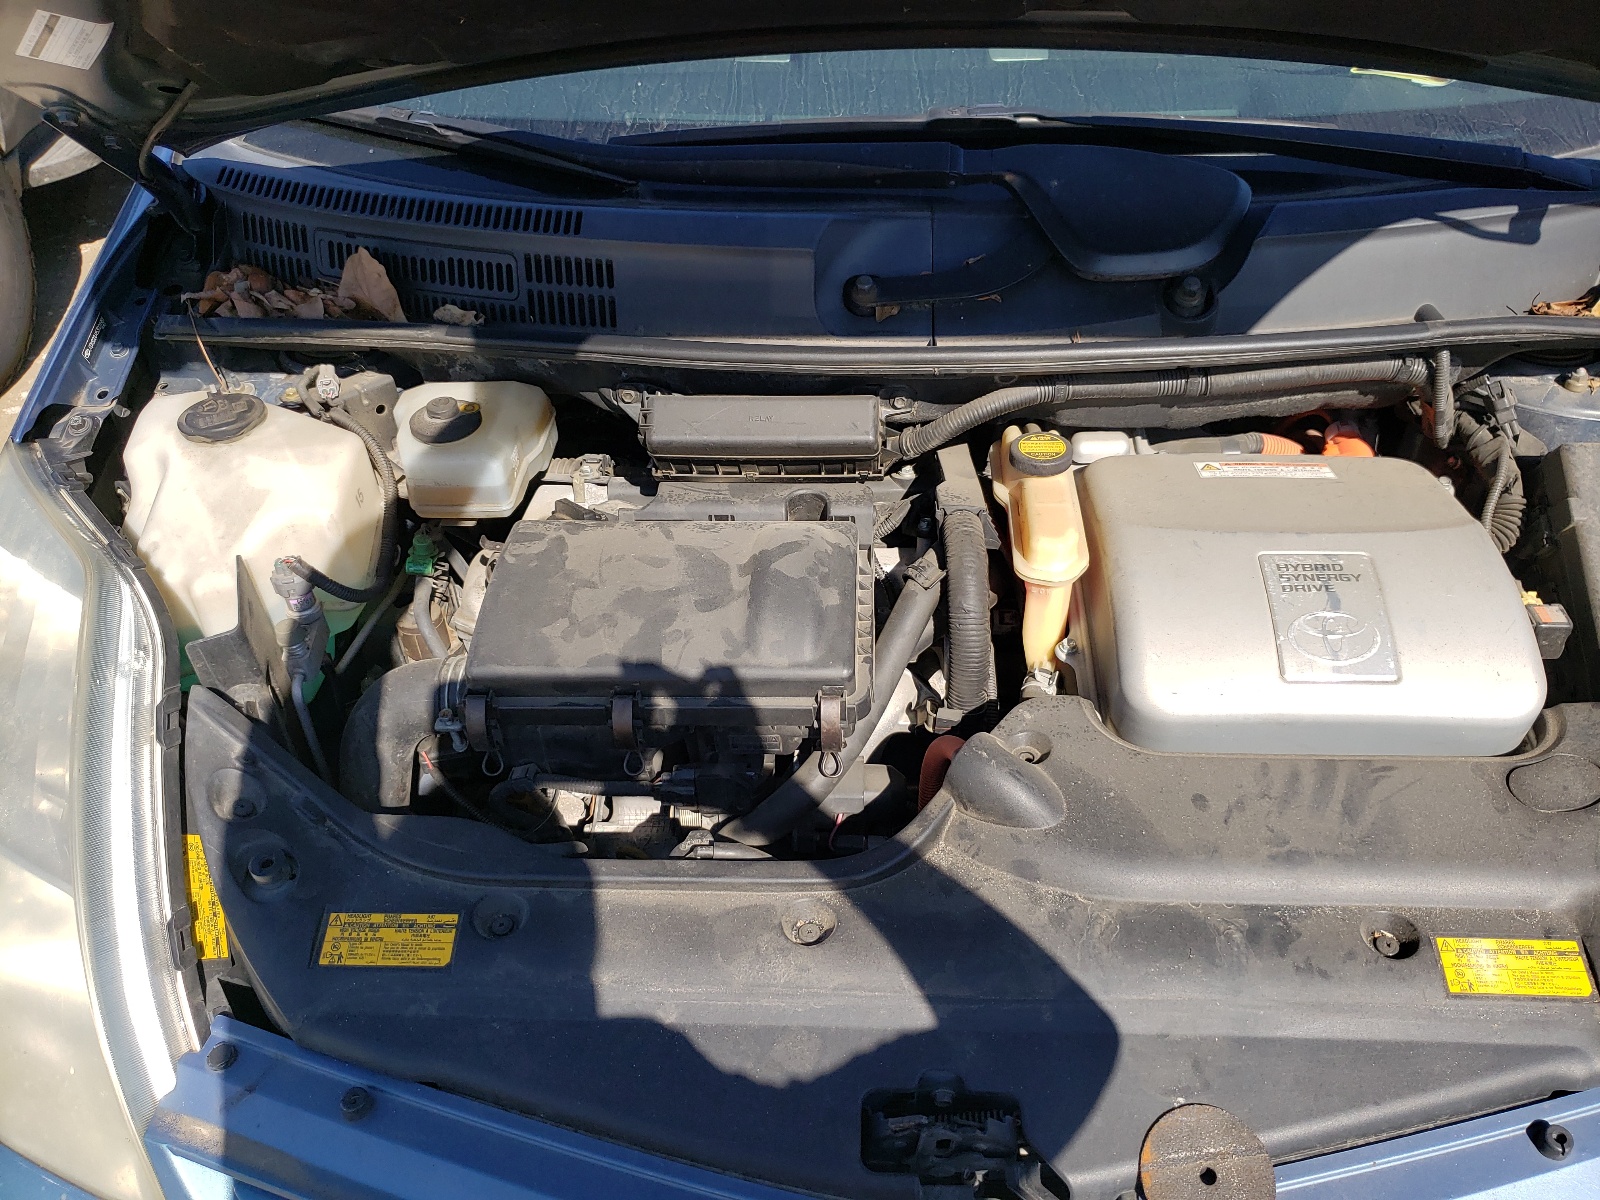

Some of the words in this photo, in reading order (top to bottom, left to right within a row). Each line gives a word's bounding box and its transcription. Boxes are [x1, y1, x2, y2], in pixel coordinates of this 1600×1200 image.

[748, 415, 775, 423] RELAY
[1275, 563, 1344, 572] HYBRID
[1278, 573, 1362, 582] SYNERGY
[1281, 584, 1337, 593] DRIVE
